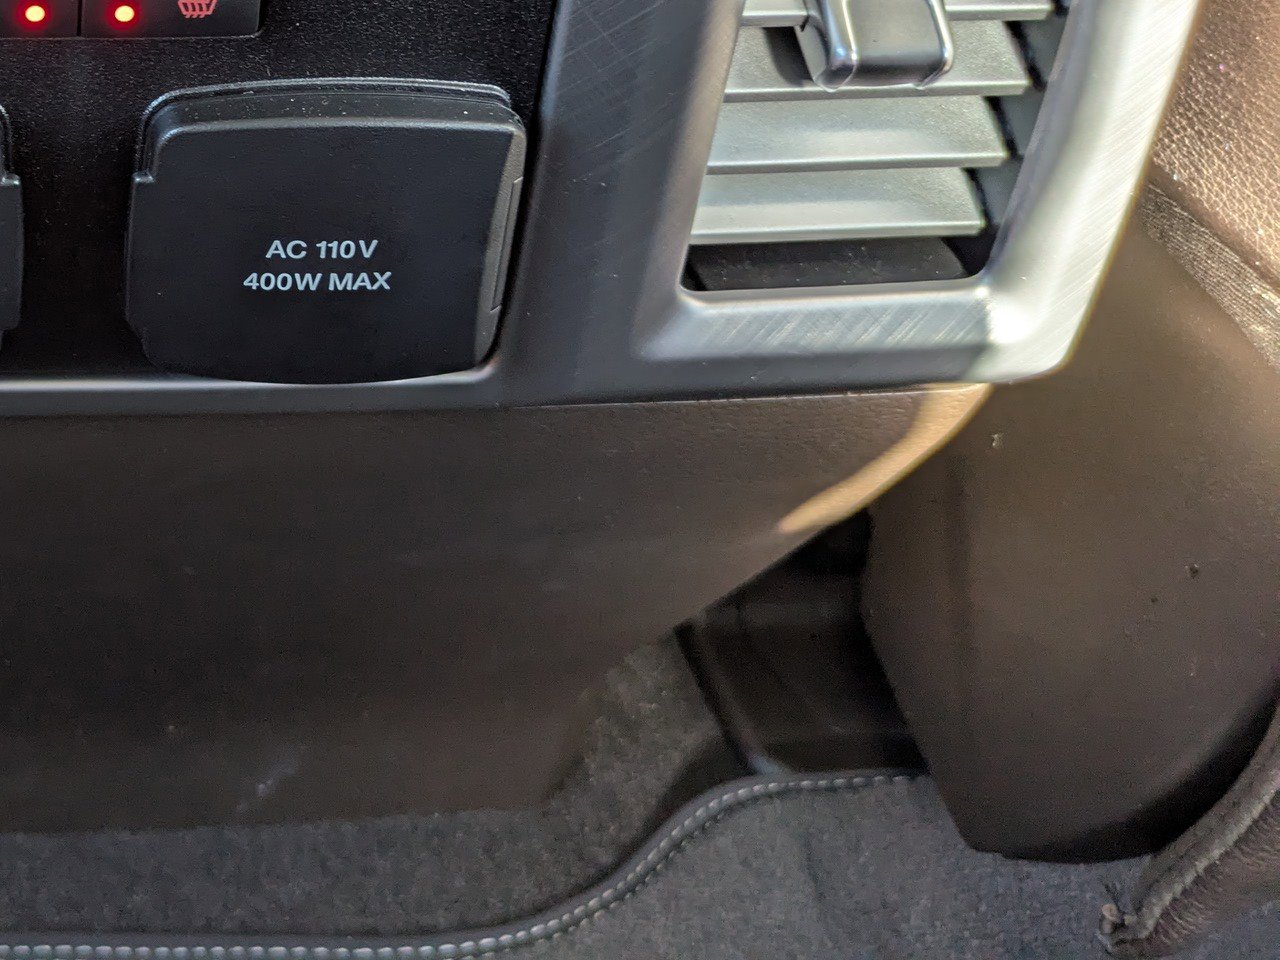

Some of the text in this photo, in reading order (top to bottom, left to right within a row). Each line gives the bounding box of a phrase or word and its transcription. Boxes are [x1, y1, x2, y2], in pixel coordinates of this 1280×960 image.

[265, 239, 379, 259] AC 110V
[243, 271, 392, 291] 400W MAX
